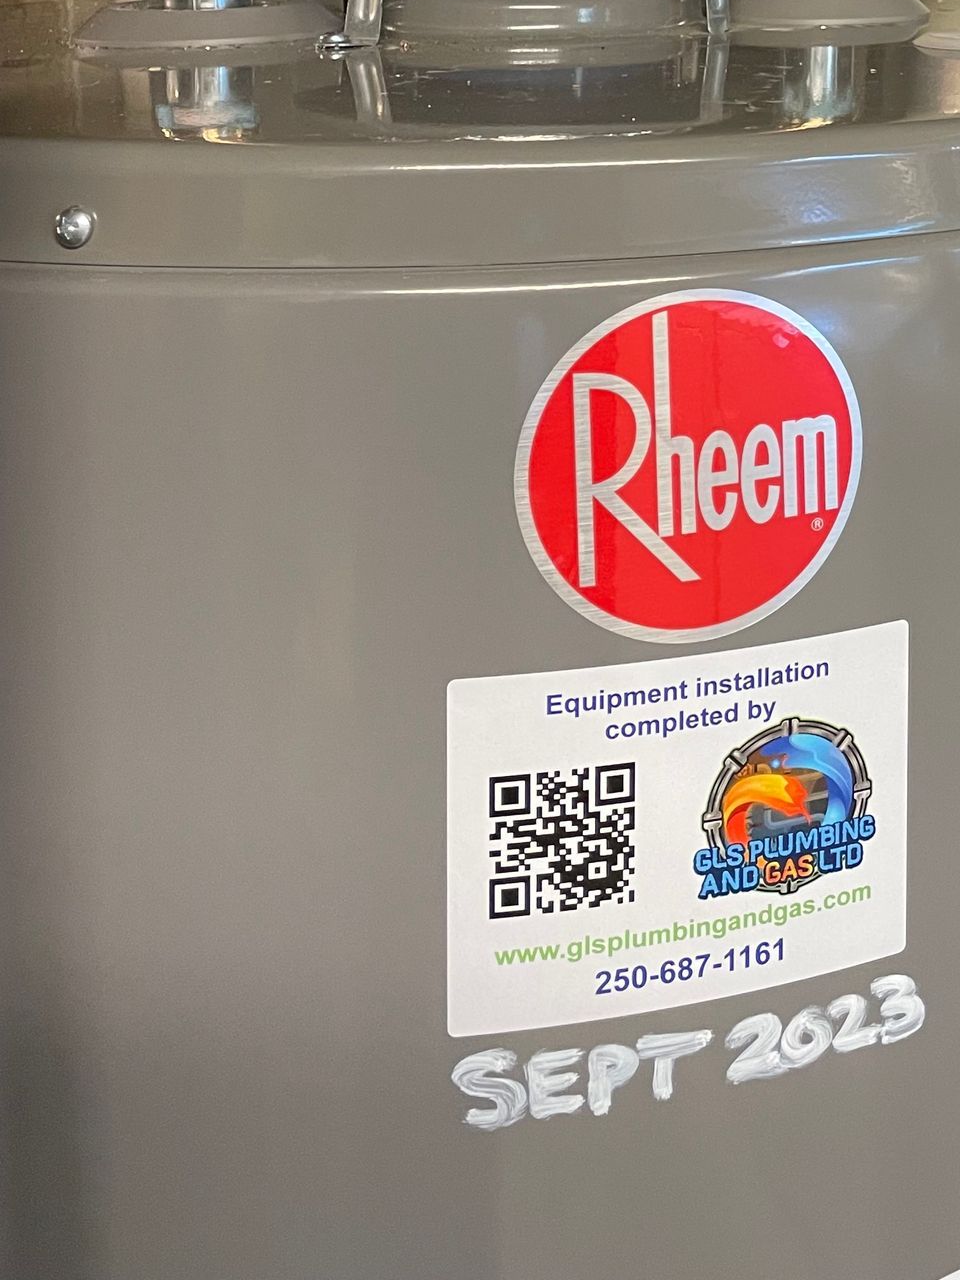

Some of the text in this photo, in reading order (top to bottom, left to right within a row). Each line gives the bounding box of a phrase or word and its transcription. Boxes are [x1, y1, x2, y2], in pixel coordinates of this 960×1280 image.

[572, 310, 839, 589] Rheem
[546, 661, 830, 718] Equipment installation
[605, 700, 777, 740] completed by
[695, 815, 876, 872] GLS PLUMBING
[700, 843, 863, 898] AND GAS LTD
[494, 883, 872, 966] www.glsplumbingandgas.com
[594, 937, 785, 996] 250-687-1161
[451, 974, 927, 1132] SEPT 2023
